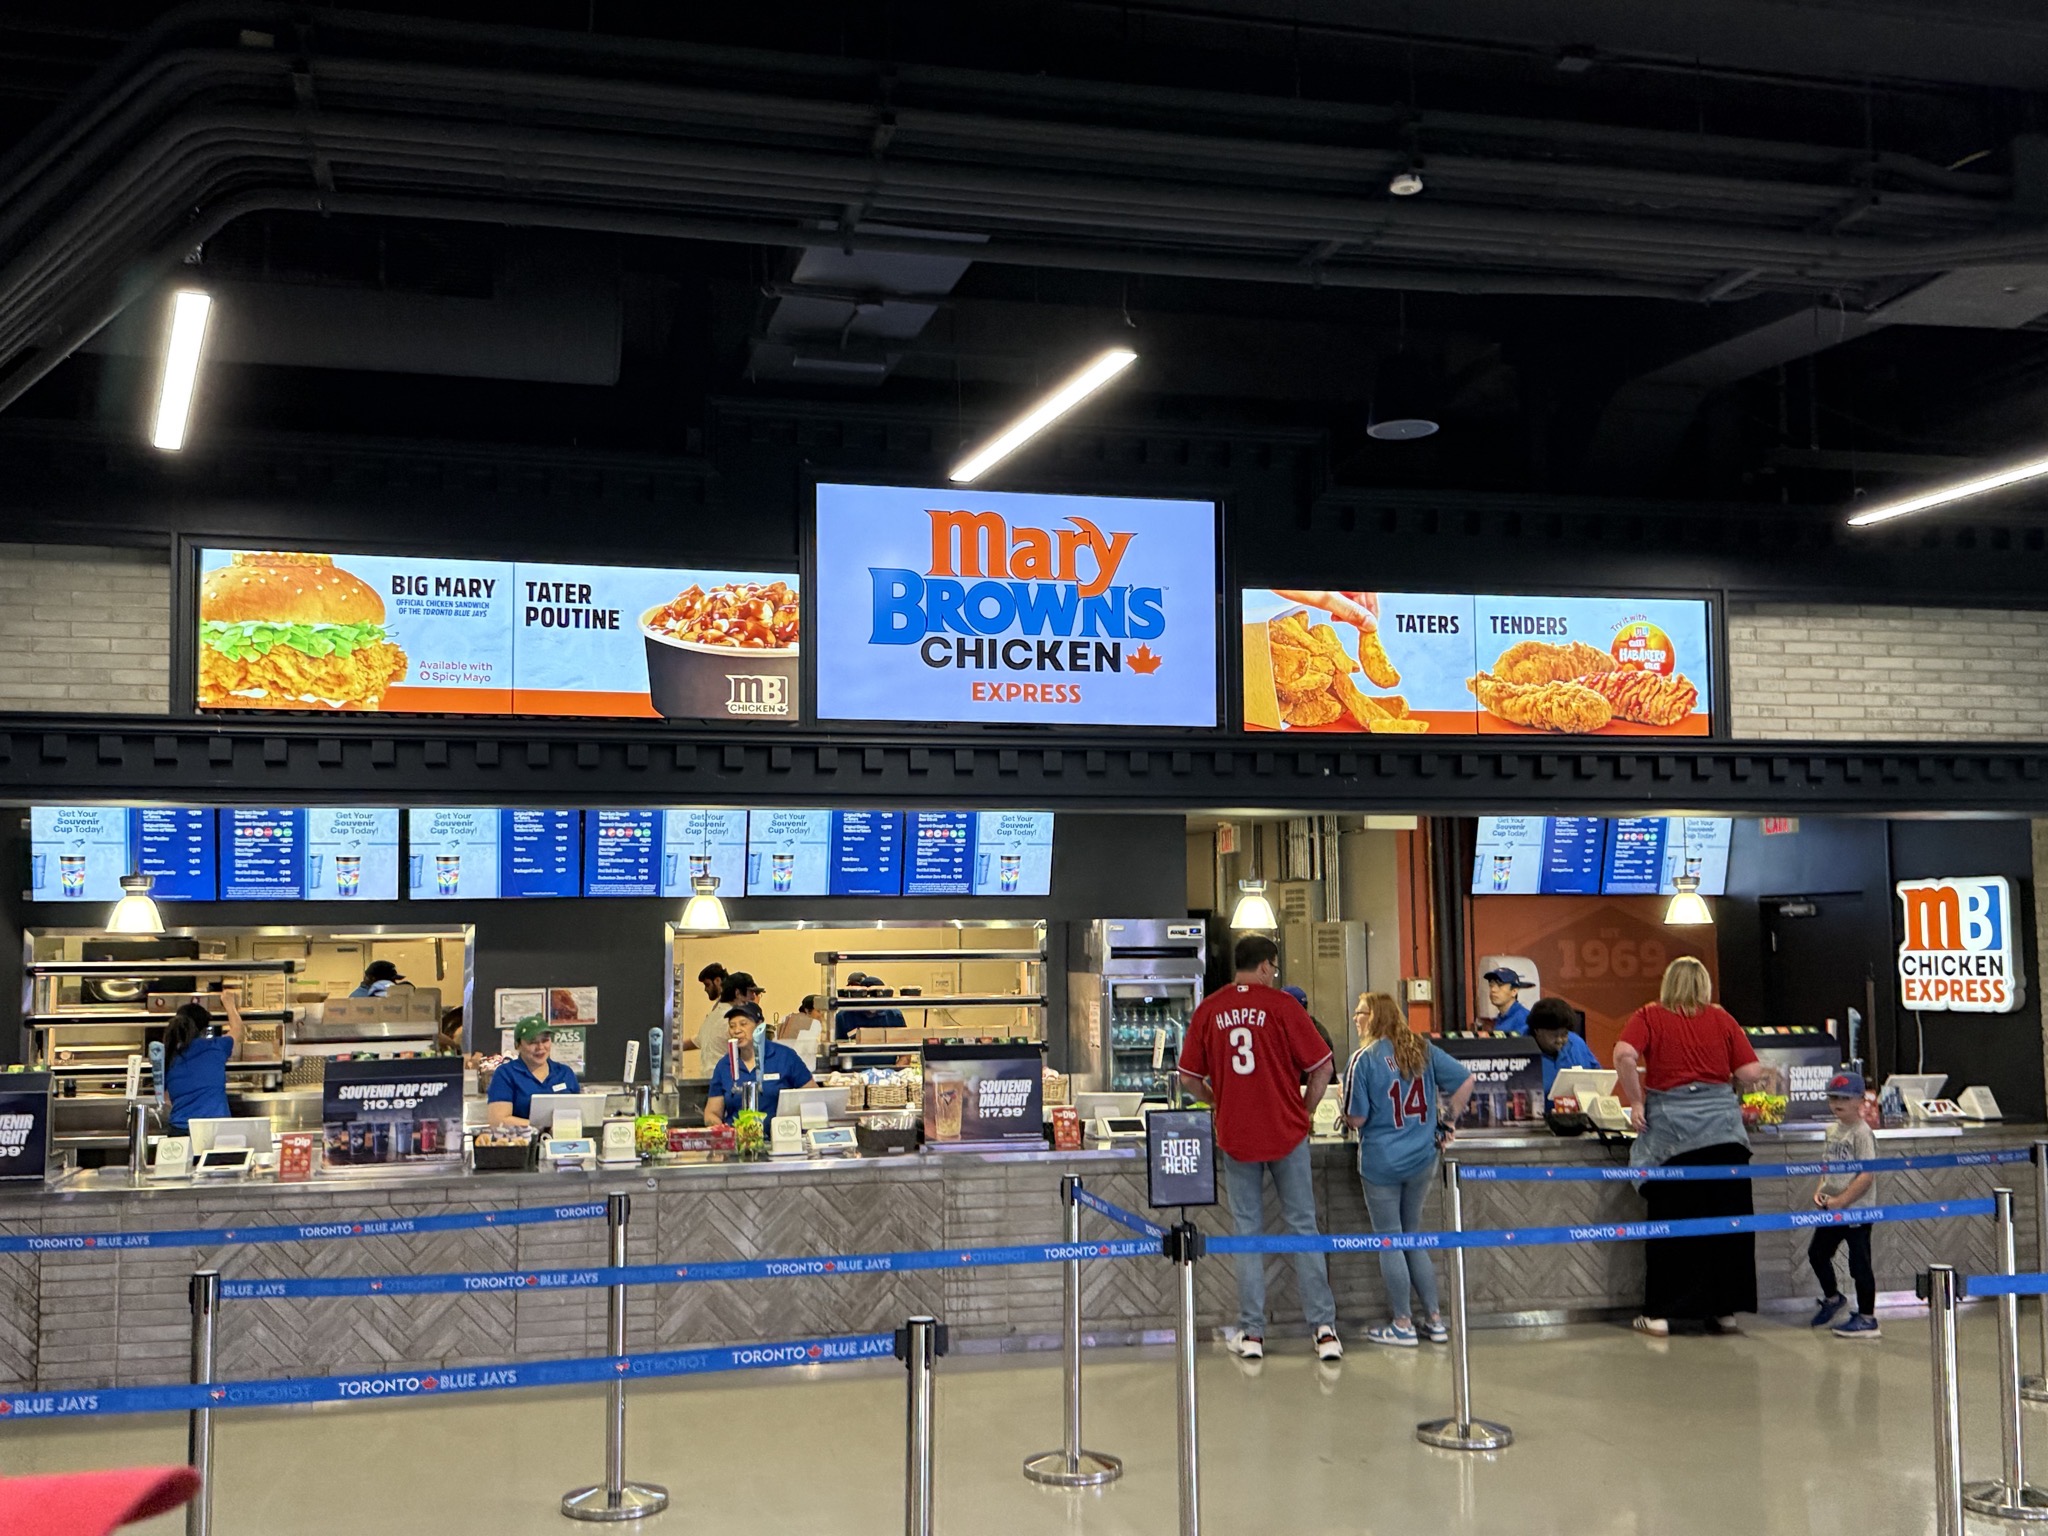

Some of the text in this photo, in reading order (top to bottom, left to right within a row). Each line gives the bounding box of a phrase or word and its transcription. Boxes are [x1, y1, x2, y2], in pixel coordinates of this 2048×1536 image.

[392, 575, 428, 596] BIG
[526, 581, 592, 605] TATER
[396, 599, 490, 609] OFFICIAL CHICKEN SANDWICH
[423, 608, 452, 616] TORONTO
[454, 609, 470, 617] BLUE
[525, 606, 620, 630] POUTINE
[1396, 614, 1459, 634] TATERS
[1490, 615, 1568, 636] TENDERS
[1610, 620, 1623, 632] Try
[1630, 613, 1647, 621] with
[920, 636, 1121, 673] CHICKEN
[419, 661, 493, 672] Available with
[432, 672, 491, 684] Spicy Mayo
[972, 681, 1082, 705] EXPRESS
[730, 704, 776, 713] CHICKEN
[58, 810, 98, 818] Get Your
[53, 826, 103, 834] Cup Today!
[330, 827, 379, 835] Cup Today!
[430, 827, 477, 835] Cup Today!
[1558, 939, 1666, 979] 1969
[1902, 955, 2003, 977] CHICKEN
[1904, 979, 2006, 1004] EXPRESS
[1216, 1008, 1266, 1030] HARPER
[554, 1031, 581, 1043] PASS
[1229, 1027, 1256, 1075] 3
[1492, 1059, 1509, 1071] POP
[1789, 1066, 1833, 1079] SOUVENIR
[339, 1084, 395, 1100] SOUVENIR
[395, 1083, 419, 1097] POP
[978, 1080, 1032, 1094] SOUVENIR
[978, 1093, 1028, 1107] DRAUGHT
[1388, 1076, 1428, 1129] 14
[1062, 1110, 1077, 1120] Dip
[294, 1137, 311, 1148] Dip
[1161, 1139, 1201, 1157] ENTER
[1165, 1156, 1198, 1175] HERE
[1957, 1155, 1990, 1165] TORONTO
[1478, 1169, 1496, 1179] JAYS
[1603, 1168, 1685, 1179] TORONTO BLUE JAYS
[1786, 1165, 1821, 1175] TORONTO
[555, 1206, 604, 1218] TORONTO
[1791, 1209, 1884, 1226] TORONTO BLUE JAYS
[299, 1221, 414, 1237] TORONTO BLUE JAYS
[1569, 1224, 1671, 1241] TORONTO BLUE JAYS
[28, 1235, 150, 1249] TORONTO BLUE JAYS
[1044, 1241, 1162, 1258] TORONTO BLUE JAYS
[1332, 1236, 1439, 1249] TORONTO BLUE JAYS
[766, 1258, 891, 1275] TORONTO BLUE JAYS
[464, 1273, 598, 1289] TORONTO BLUE JAYS
[223, 1284, 286, 1296] BLUE JAYS
[732, 1338, 894, 1365] TORONTO BLUE JAYS
[339, 1370, 517, 1395] TORONTO BLUE JAYS
[14, 1396, 98, 1414] BLUE JAYS
